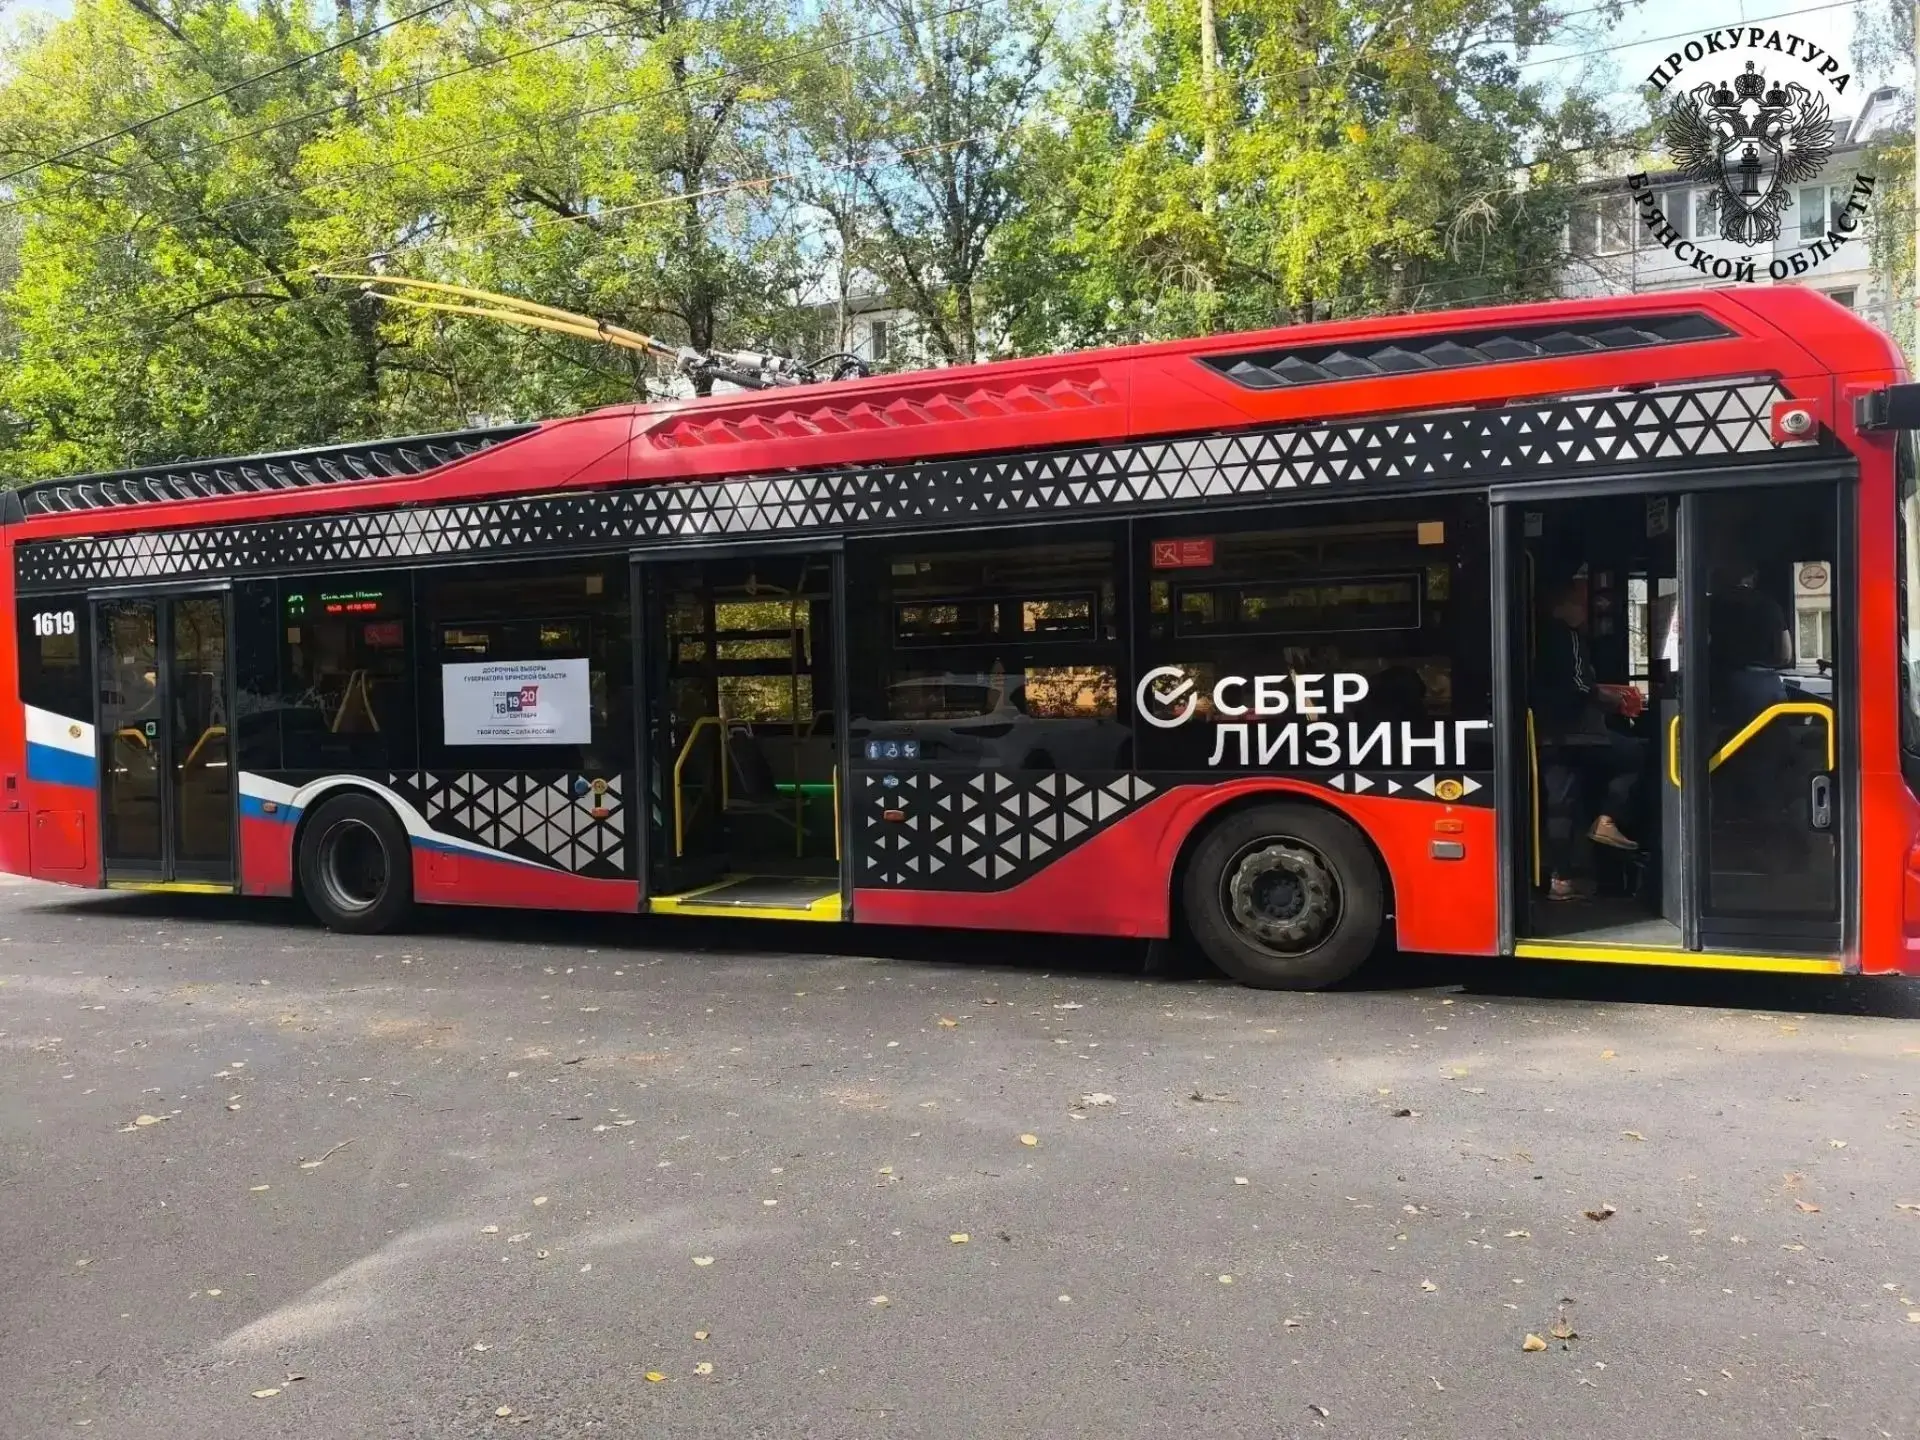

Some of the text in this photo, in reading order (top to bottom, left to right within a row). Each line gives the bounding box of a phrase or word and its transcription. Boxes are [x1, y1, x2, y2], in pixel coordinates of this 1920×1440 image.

[32, 611, 75, 636] 1619
[464, 672, 567, 682] ГУБЕРНАТОРА БРЯНСКОЙ ОБЛАСТИ
[482, 666, 519, 674] ДОСРОЧНЫЕ
[495, 691, 535, 714] 18 19 20
[1212, 673, 1370, 716] СБЕР
[1208, 720, 1489, 767] ЛИЗИНГ
